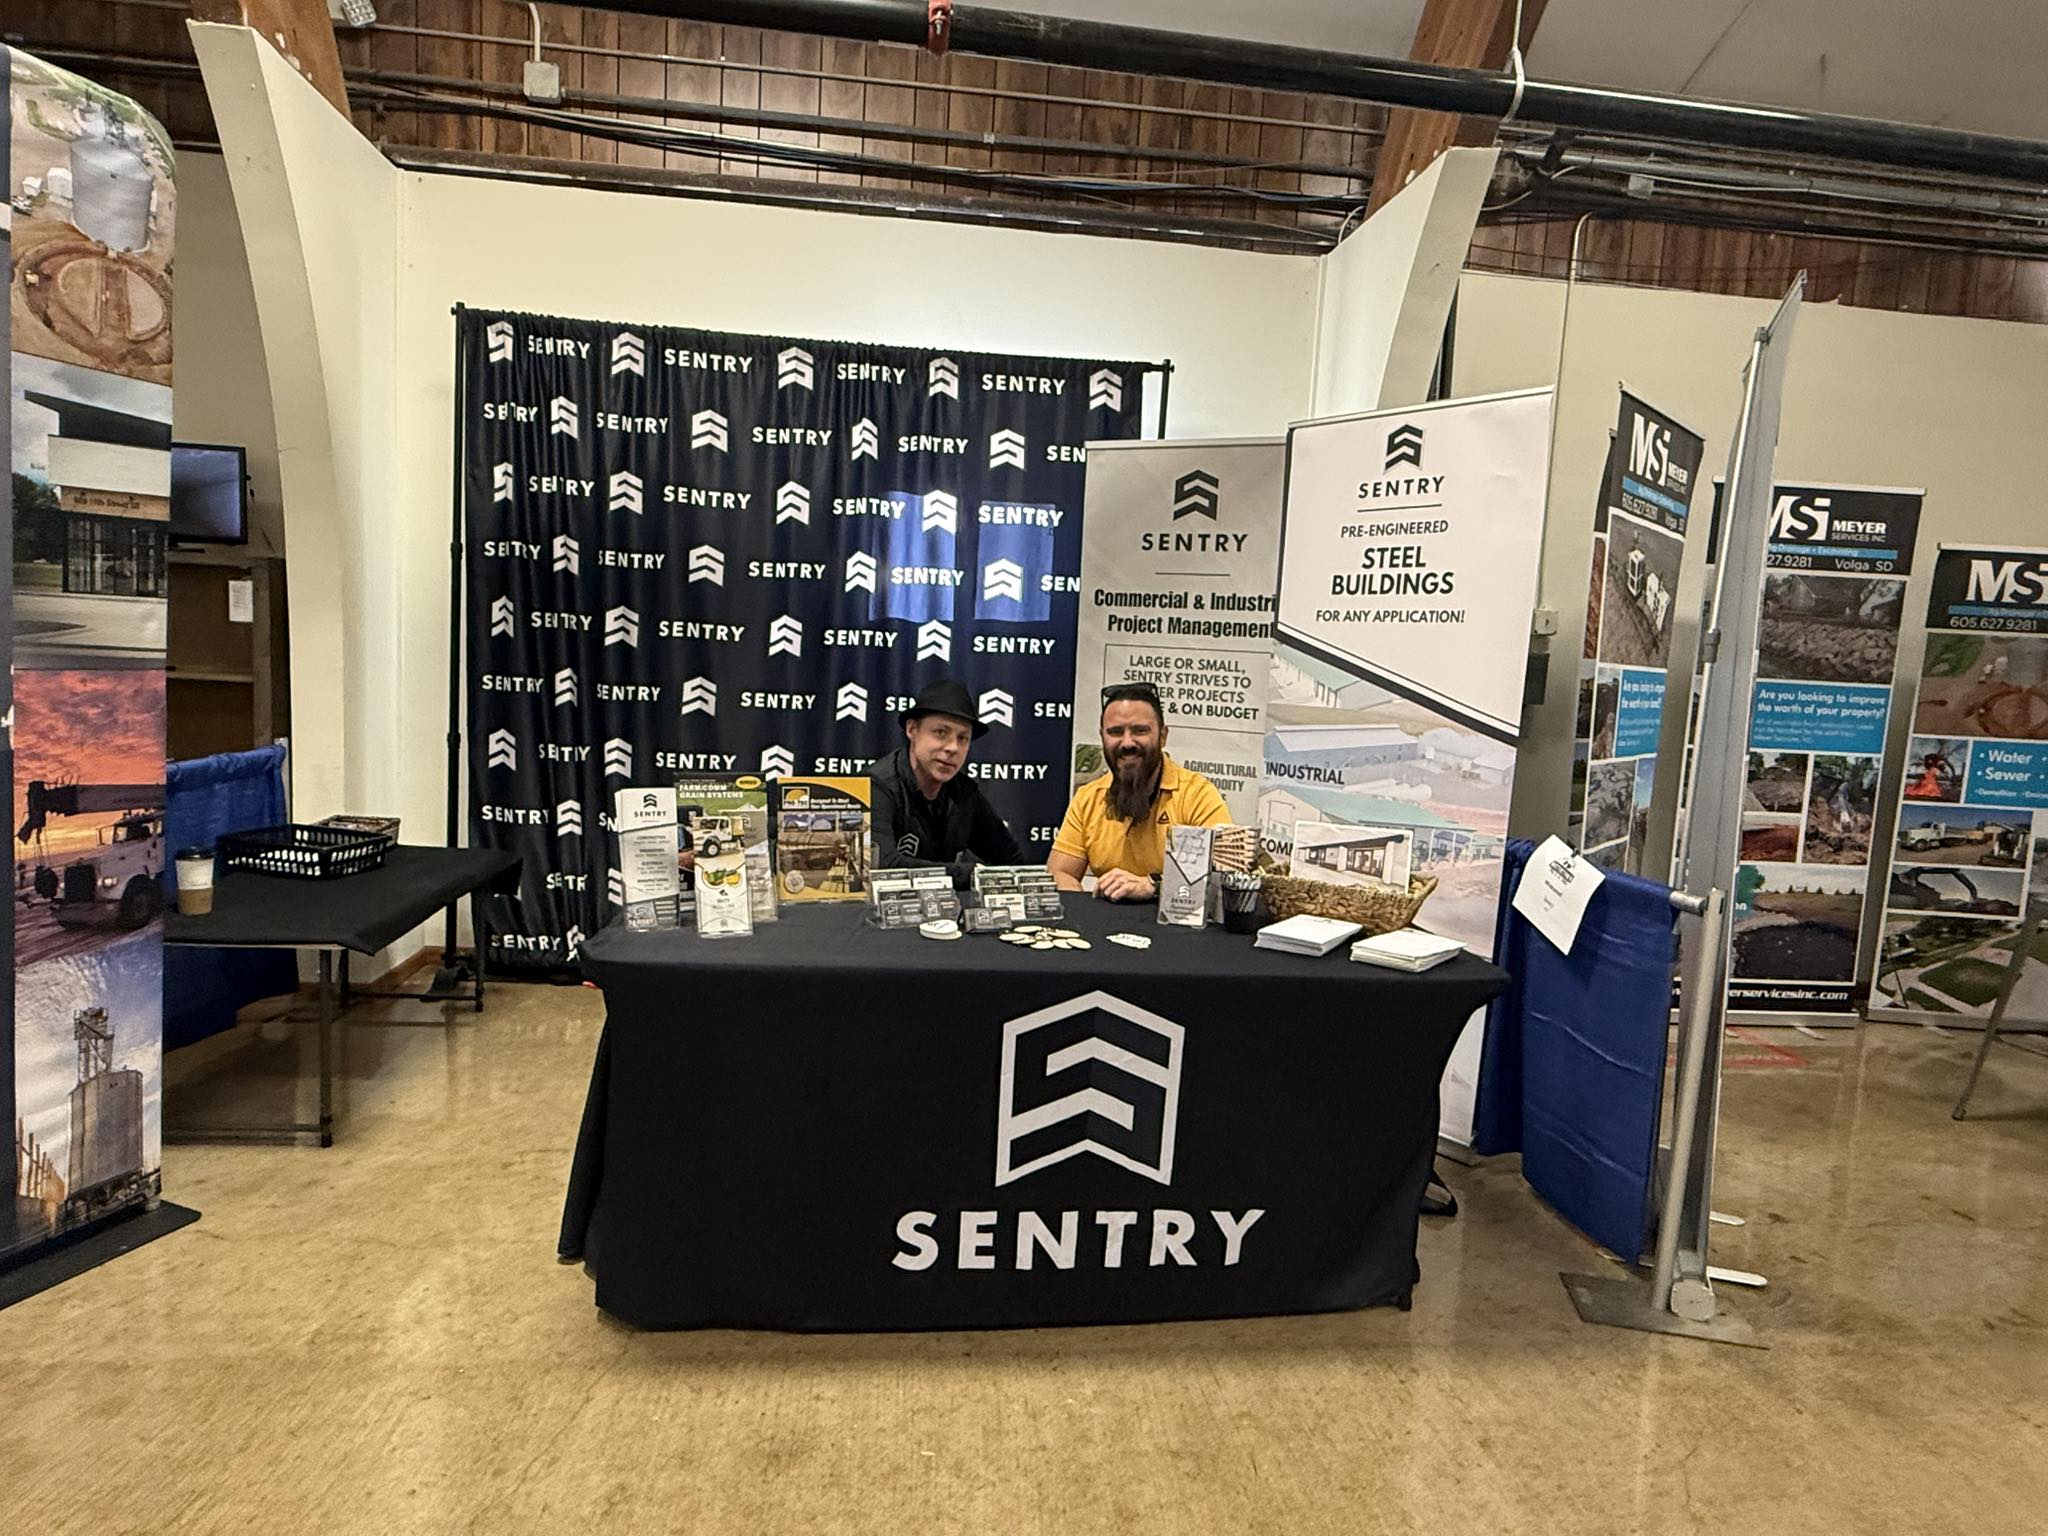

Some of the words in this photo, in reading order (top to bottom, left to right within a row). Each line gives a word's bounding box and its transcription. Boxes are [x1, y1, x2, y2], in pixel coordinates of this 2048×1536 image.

[665, 349, 752, 373] SENTRY
[837, 363, 905, 384] SENTRY
[982, 374, 1065, 395] SENTRY
[597, 412, 668, 434] SENTRY
[752, 427, 832, 445] SENTRY
[899, 435, 968, 454] SENTRY
[1046, 445, 1085, 463] SEN
[1358, 476, 1445, 498] SENTRY
[664, 486, 751, 509] SENTRY
[833, 498, 905, 519] SENTRY
[979, 505, 1063, 527] SENTRY
[1341, 520, 1449, 538] PRE-ENGINEERED
[1832, 520, 1887, 533] MEYER
[1142, 533, 1248, 551] SENTRY
[1831, 532, 1870, 541] SERVICES
[1871, 533, 1886, 542] INC
[1361, 546, 1427, 569] STEEL
[1767, 554, 1812, 567] 27.9281
[1835, 559, 1870, 571] Volga
[1875, 561, 1893, 571] SD
[749, 562, 825, 579] SENTRY
[891, 567, 964, 585] SENTRY
[1040, 575, 1080, 592] SEN
[1331, 572, 1454, 595] BUILDINGS
[1094, 589, 1188, 609] Commercial
[1193, 594, 1204, 609] &
[1210, 592, 1276, 612] Industri
[1107, 615, 1163, 634] Project
[1316, 610, 1341, 622] FOR
[1343, 610, 1371, 622] ANY
[1372, 609, 1465, 623] APPLICATION!
[1950, 616, 2037, 630] 605.627.9281
[659, 621, 744, 641] SENTRY
[824, 630, 897, 647] SENTRY
[973, 636, 1055, 654] SENTRY
[1130, 655, 1171, 669] LARGE
[1174, 658, 1194, 670] OR
[1197, 659, 1246, 675] SMALL,
[482, 675, 544, 692] SENTRY
[1123, 669, 1172, 684] SENTRY
[1175, 673, 1229, 687] STRIVES
[1232, 676, 1251, 689] TO
[597, 684, 660, 701] SENTRY
[741, 692, 815, 709] SENTRY
[1178, 688, 1246, 704] PROJECTS
[1759, 690, 1775, 699] Are
[1778, 692, 1795, 701] you
[1034, 702, 1071, 717] SEN
[1168, 702, 1178, 714] &
[1181, 703, 1203, 716] ON
[1206, 705, 1259, 720] BUDGET
[656, 752, 736, 770] SENTRY
[814, 757, 876, 774] SENT
[1988, 750, 2033, 764] Water
[968, 763, 1047, 779] SENTRY
[1183, 760, 1258, 778] AGRICULTURAL
[1265, 762, 1345, 785] INDUSTRIAL
[1985, 767, 2031, 781] Sewer
[634, 810, 667, 818] SENTRY
[892, 1209, 1265, 1270] SENTRY
